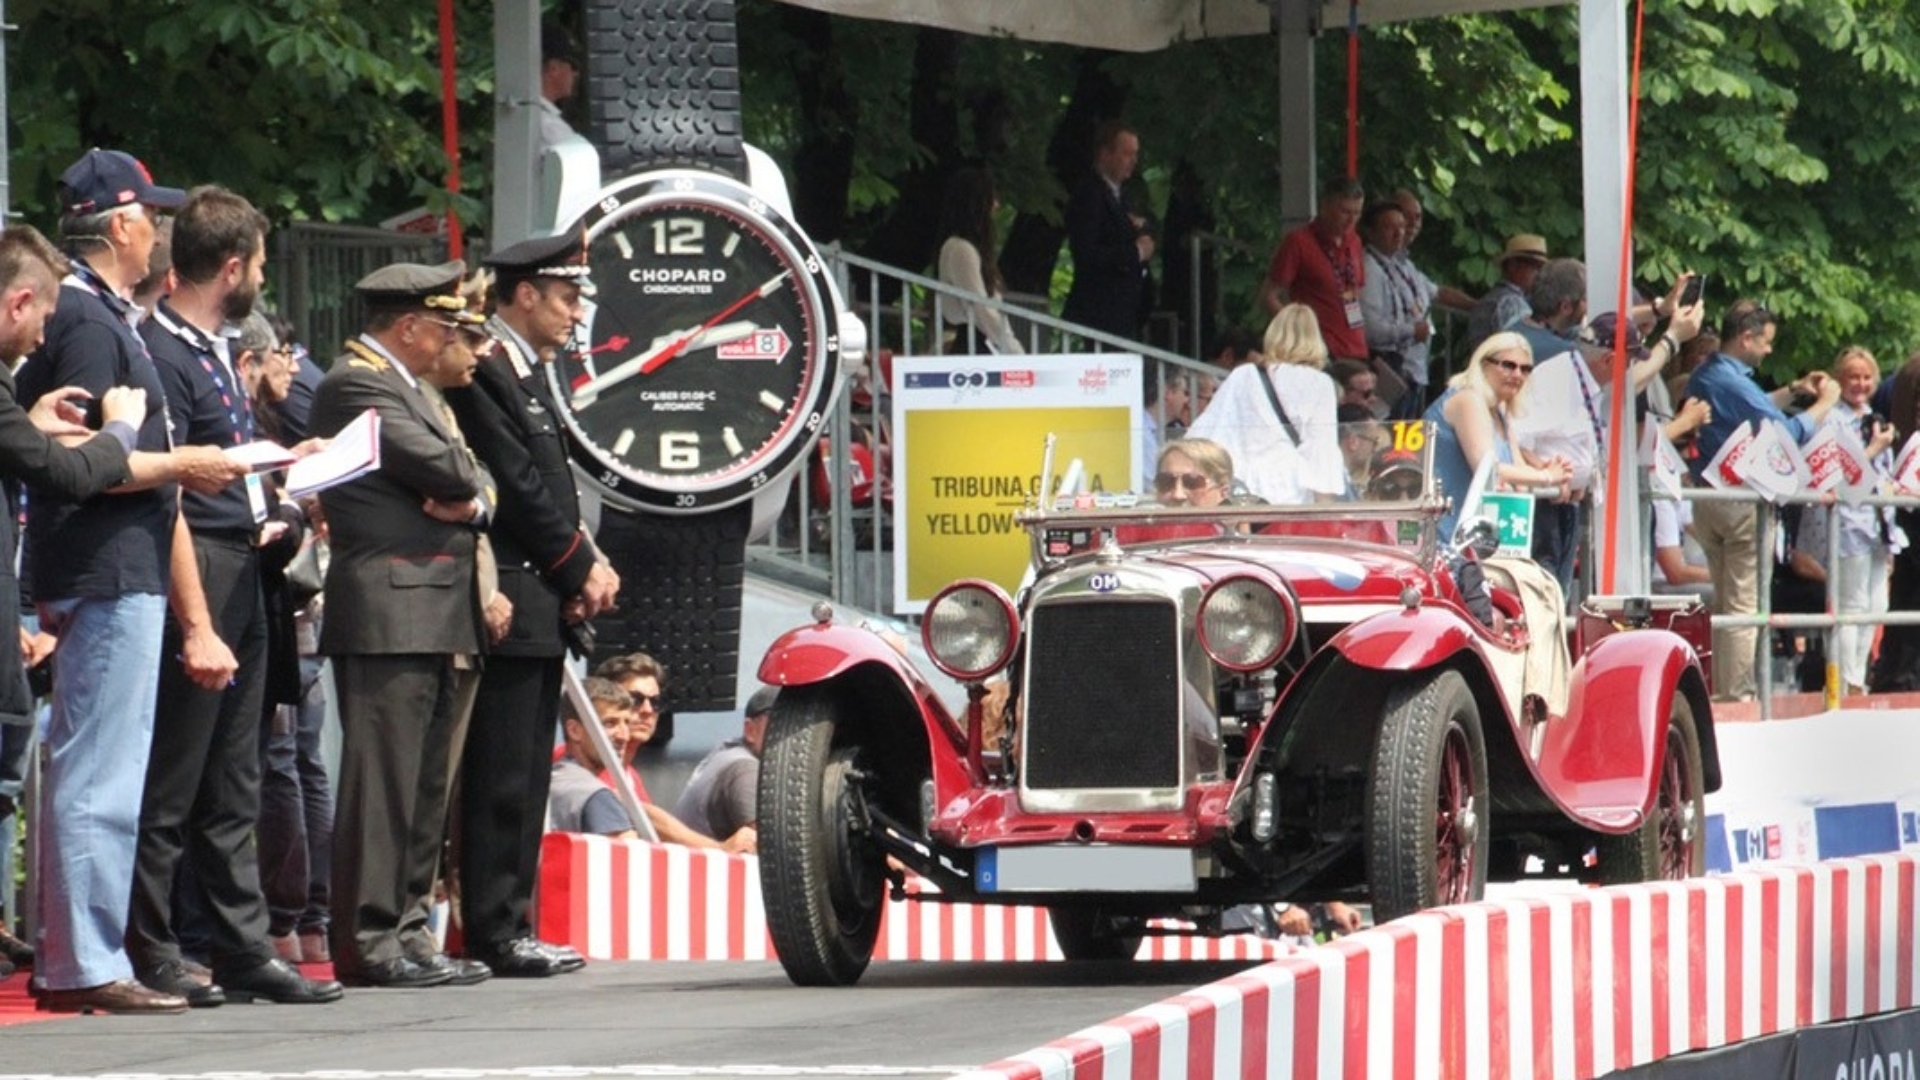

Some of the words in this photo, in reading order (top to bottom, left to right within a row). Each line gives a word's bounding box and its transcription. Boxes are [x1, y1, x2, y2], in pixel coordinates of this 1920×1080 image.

[674, 178, 695, 192] 60
[600, 193, 621, 215] 55
[651, 218, 704, 255] 12
[805, 253, 820, 274] 10
[628, 268, 727, 283] CHOPARD
[643, 284, 713, 295] CHRONOMETER
[761, 333, 774, 353] 8
[827, 335, 838, 351] 15
[652, 401, 704, 412] AUTOMATIC
[806, 411, 821, 432] 20
[1393, 420, 1425, 452] 16
[660, 431, 700, 469] 6
[600, 470, 622, 488] 35
[750, 470, 768, 489] 25
[931, 475, 1024, 498] TRIBUNA
[1029, 473, 1104, 497] GAA
[675, 494, 696, 507] 30
[926, 513, 1013, 536] YELLOW
[1091, 574, 1117, 590] OM
[983, 871, 992, 883] D
